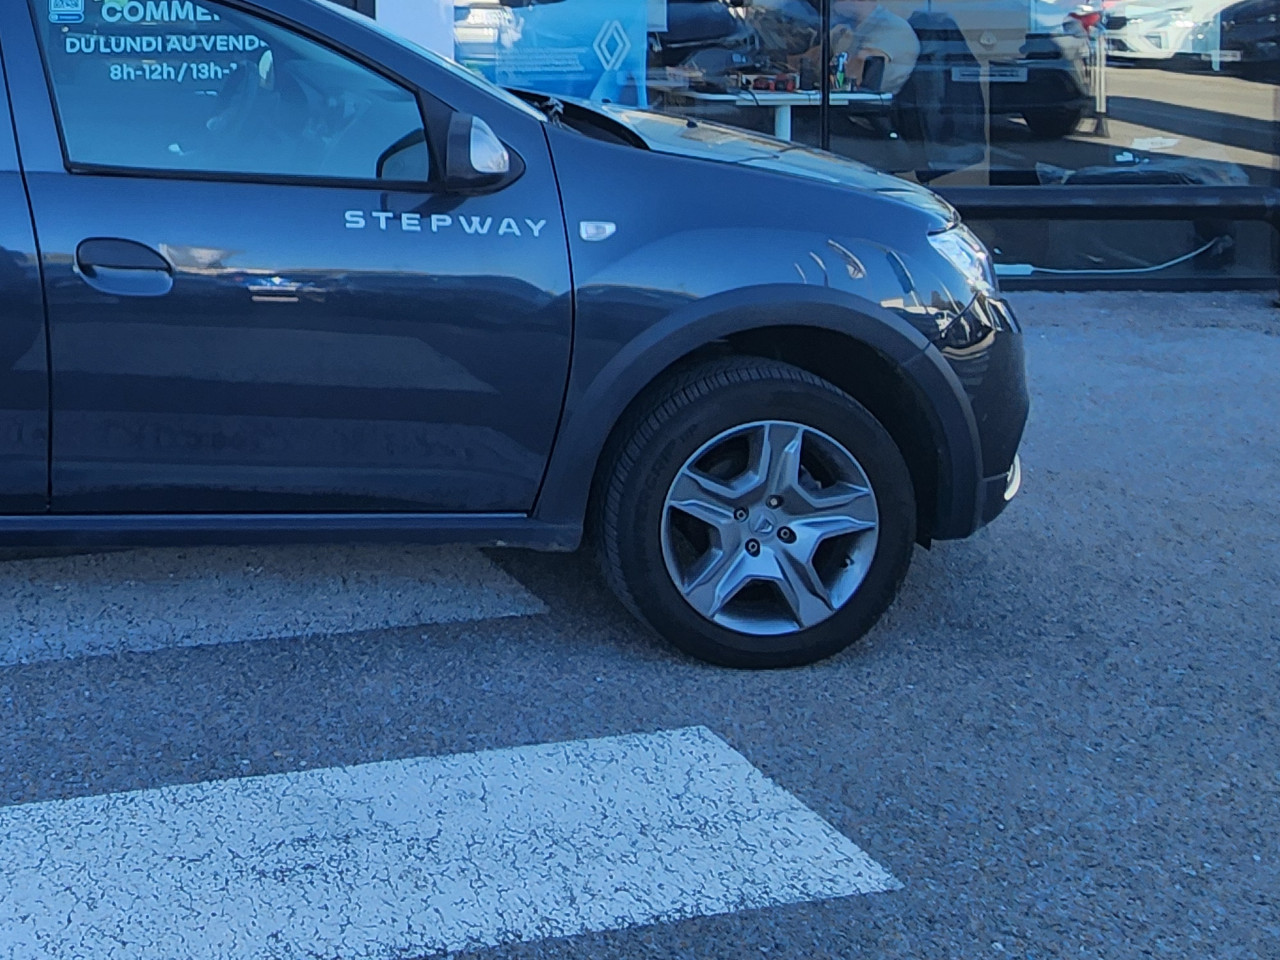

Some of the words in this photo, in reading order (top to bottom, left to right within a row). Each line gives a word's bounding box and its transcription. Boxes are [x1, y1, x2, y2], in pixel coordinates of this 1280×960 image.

[101, 0, 220, 23] COMME
[65, 36, 95, 53] DU
[99, 35, 162, 53] LUNDI
[167, 35, 196, 52] AU
[199, 34, 270, 52] VEND
[344, 210, 546, 237] STEPWAY
